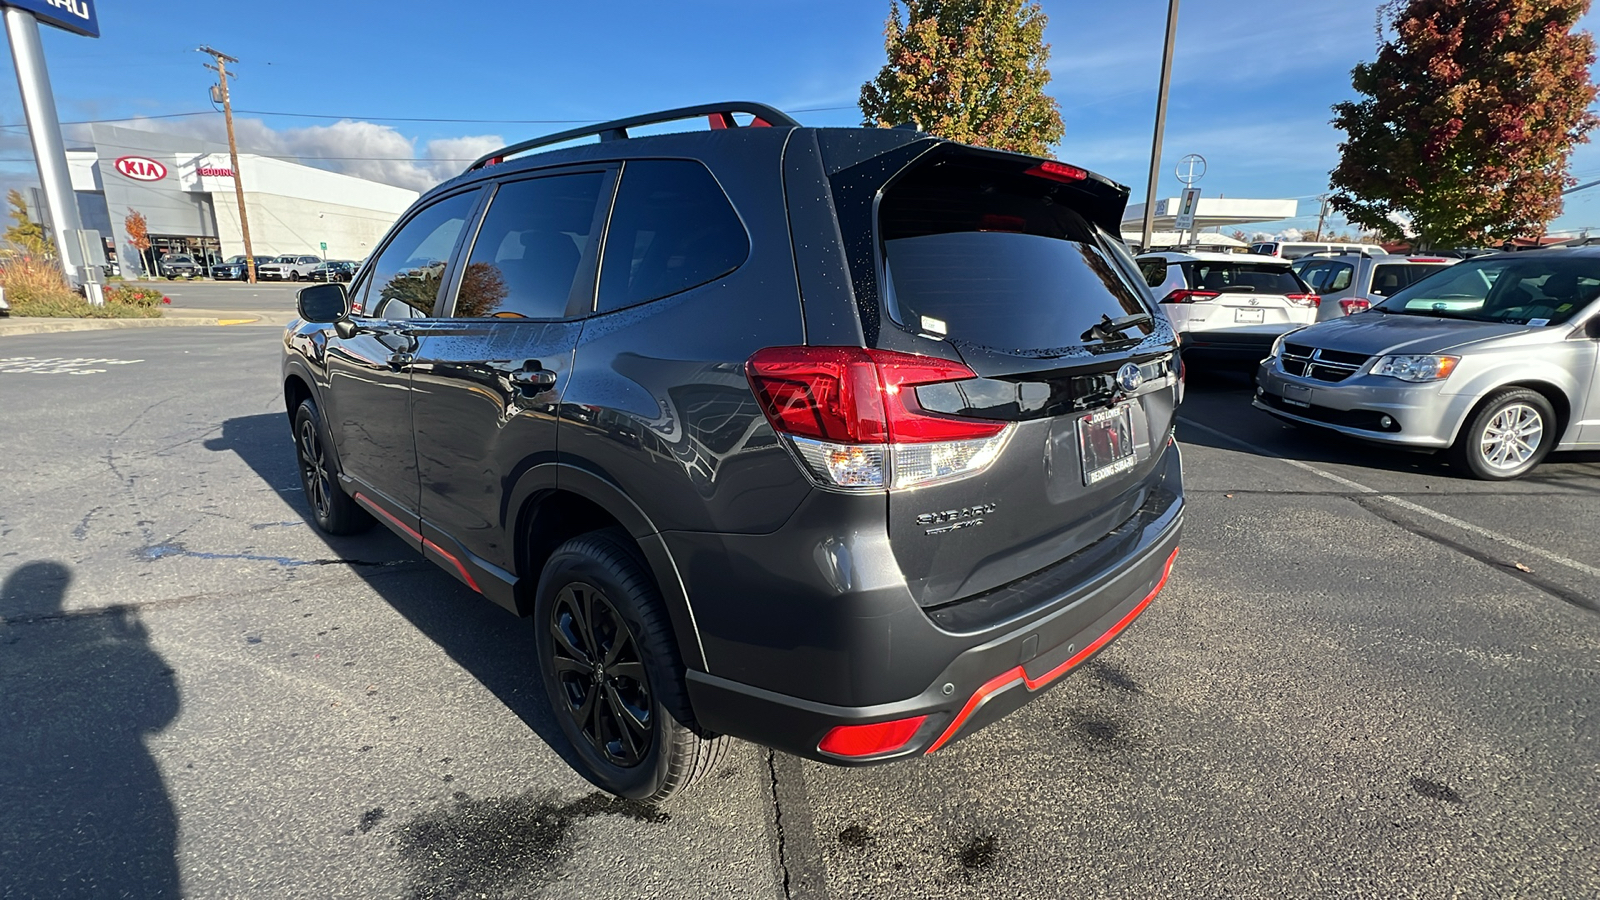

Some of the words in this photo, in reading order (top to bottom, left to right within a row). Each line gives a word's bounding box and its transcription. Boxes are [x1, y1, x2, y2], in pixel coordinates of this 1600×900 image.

[124, 160, 161, 178] KIA
[1093, 410, 1104, 424] DOG
[1090, 463, 1114, 485] REDDING
[915, 502, 995, 524] SUBARU
